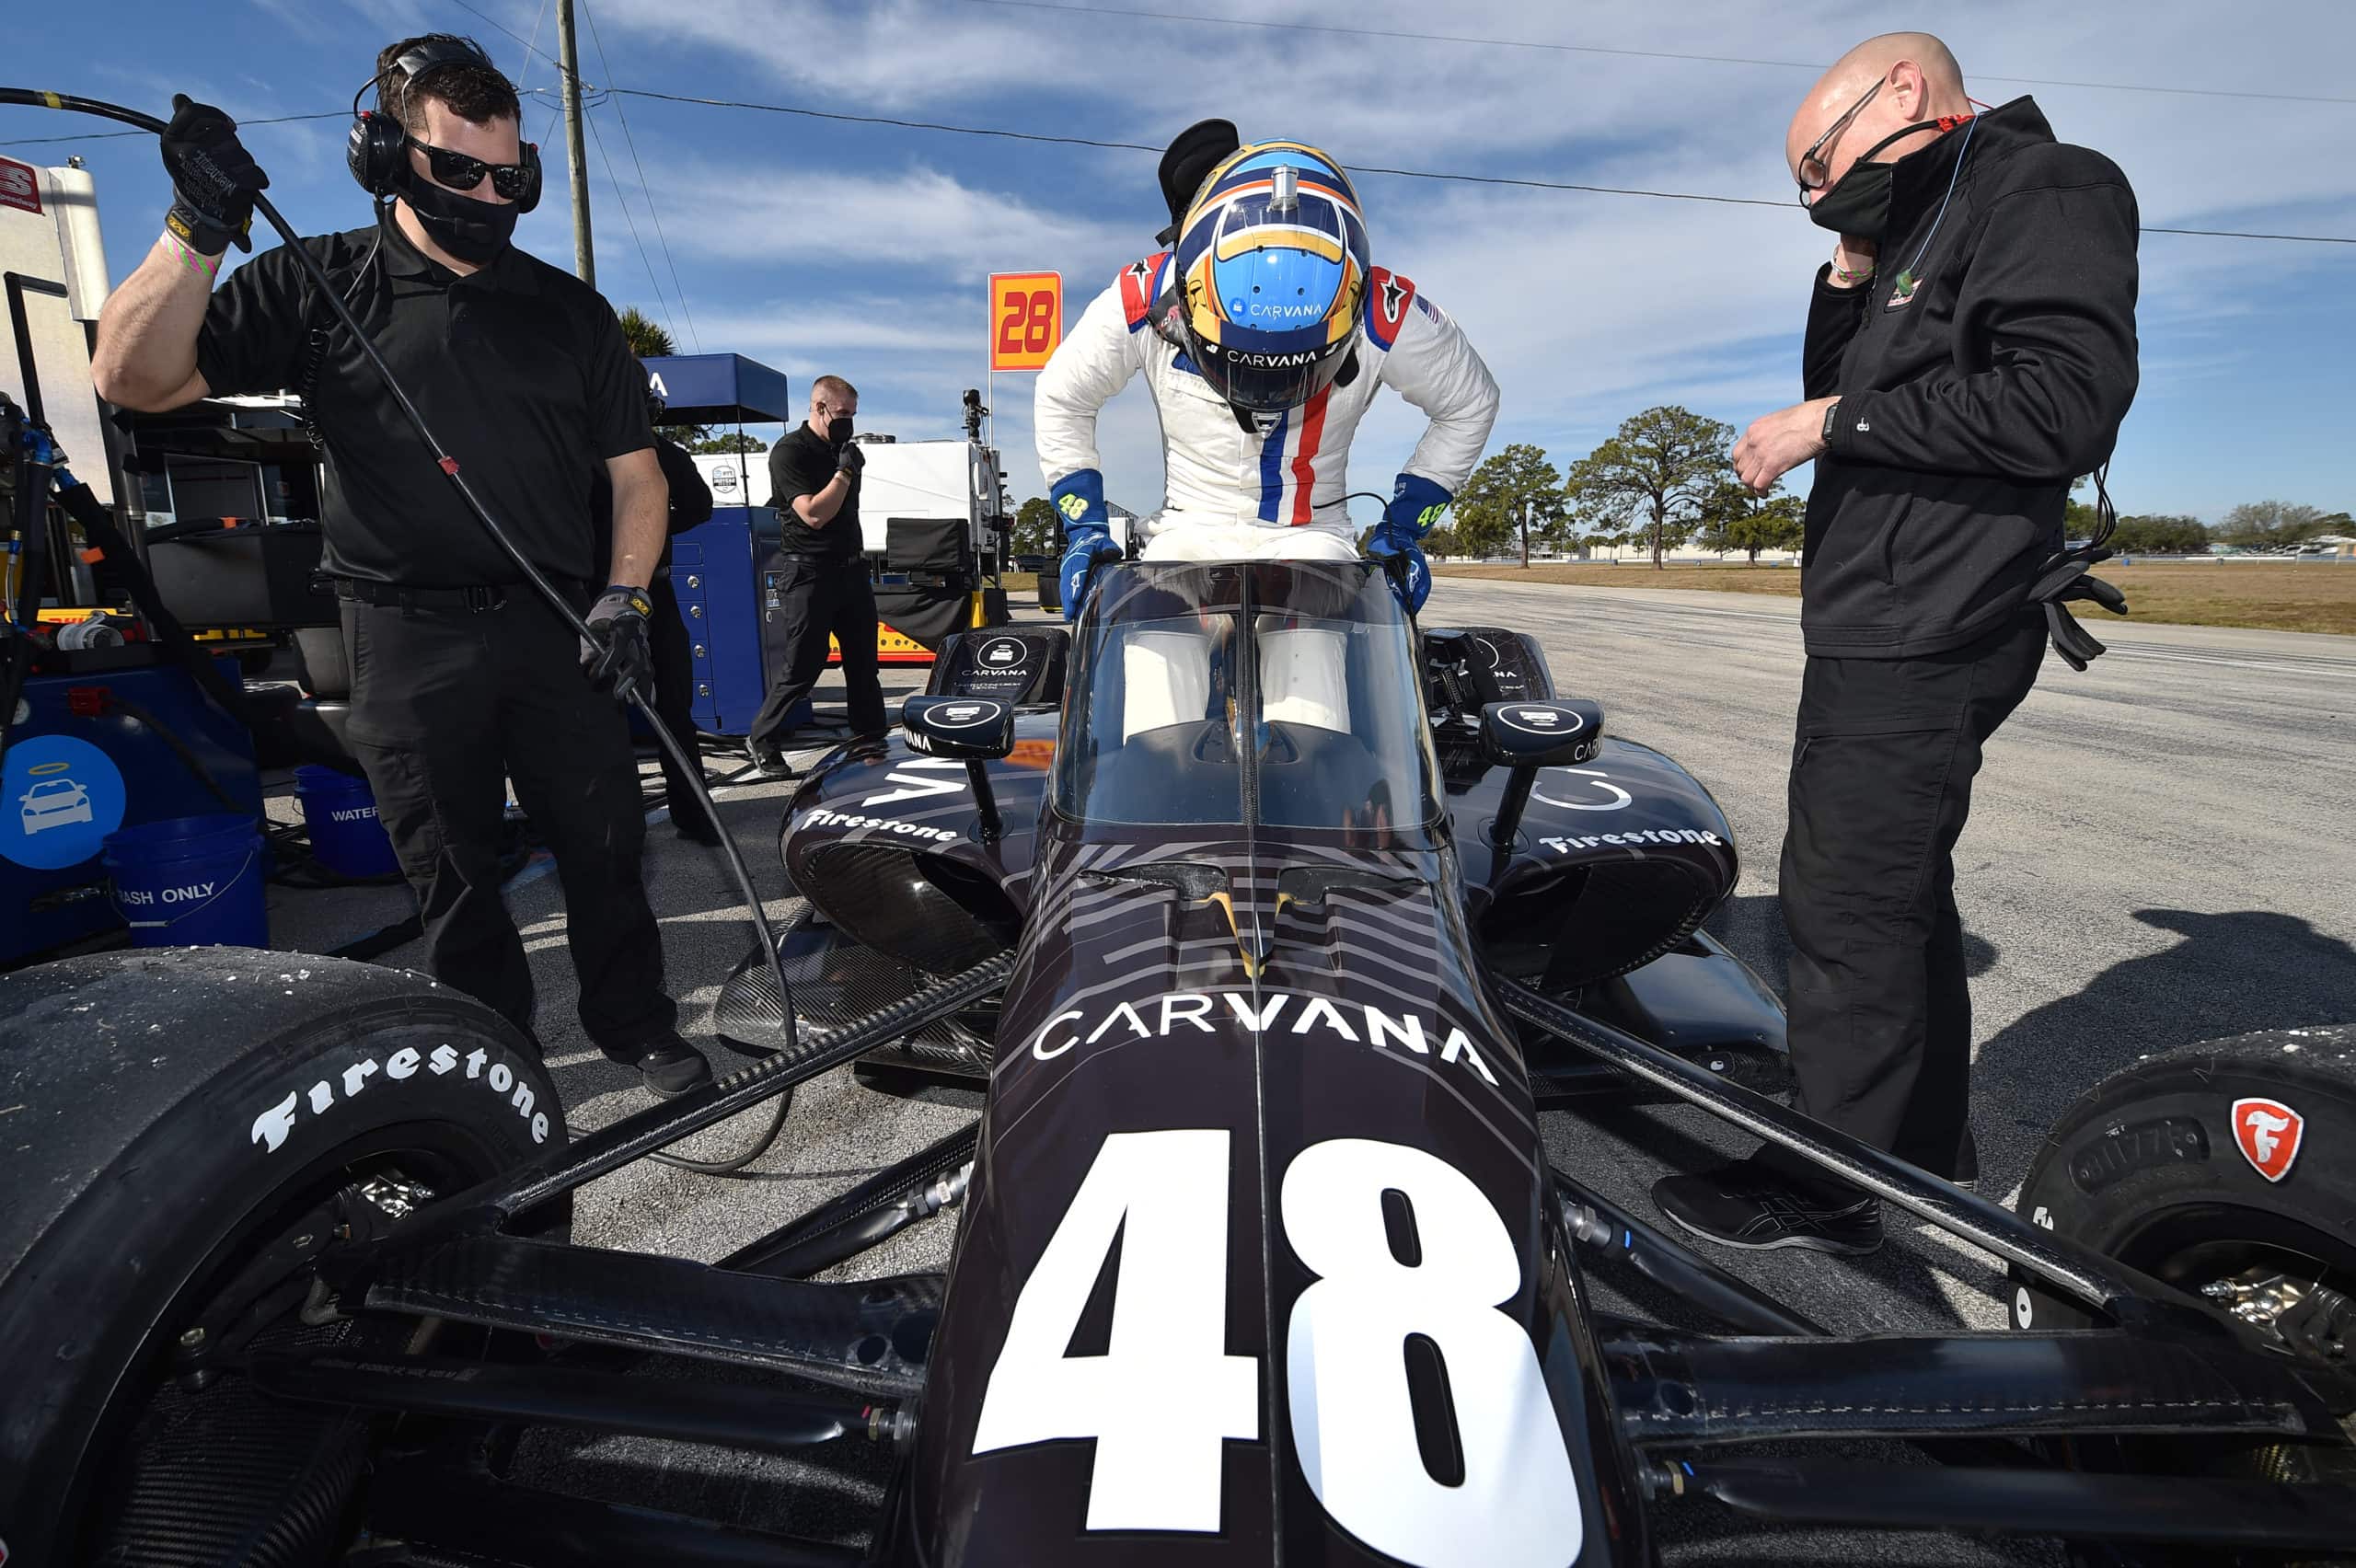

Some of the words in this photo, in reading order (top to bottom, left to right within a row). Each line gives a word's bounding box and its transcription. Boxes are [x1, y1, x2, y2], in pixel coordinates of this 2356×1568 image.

[998, 290, 1055, 354] 28
[1250, 303, 1322, 318] CARVANA
[1227, 350, 1317, 367] CARVANA
[1058, 493, 1089, 521] 48
[1417, 502, 1447, 527] 48
[801, 809, 958, 841] Firestone
[1539, 829, 1722, 854] Firestone
[161, 882, 214, 903] ONLY
[1031, 992, 1499, 1087] CARVANA
[251, 1043, 549, 1154] Firestone
[972, 1129, 1583, 1568] 48
